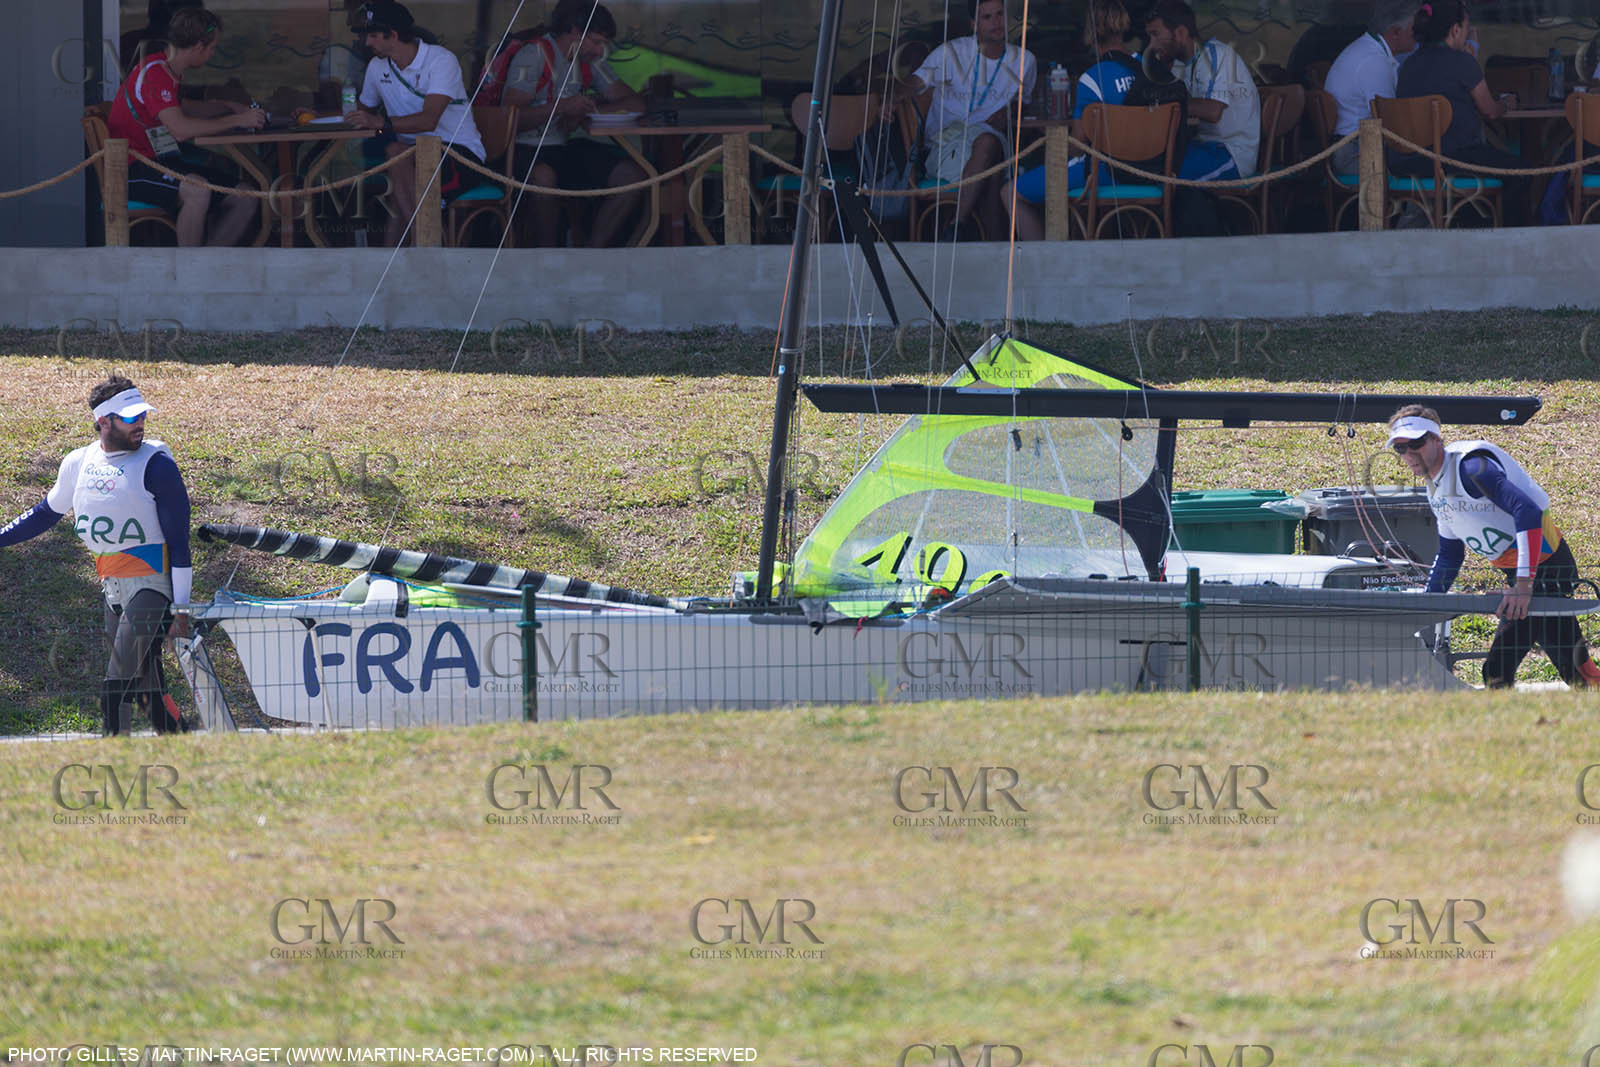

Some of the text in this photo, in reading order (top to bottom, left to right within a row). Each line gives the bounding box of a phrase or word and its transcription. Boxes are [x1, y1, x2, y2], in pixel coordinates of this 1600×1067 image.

[74, 514, 146, 544] FRA
[1466, 527, 1513, 555] RA
[303, 621, 480, 697] FRA
